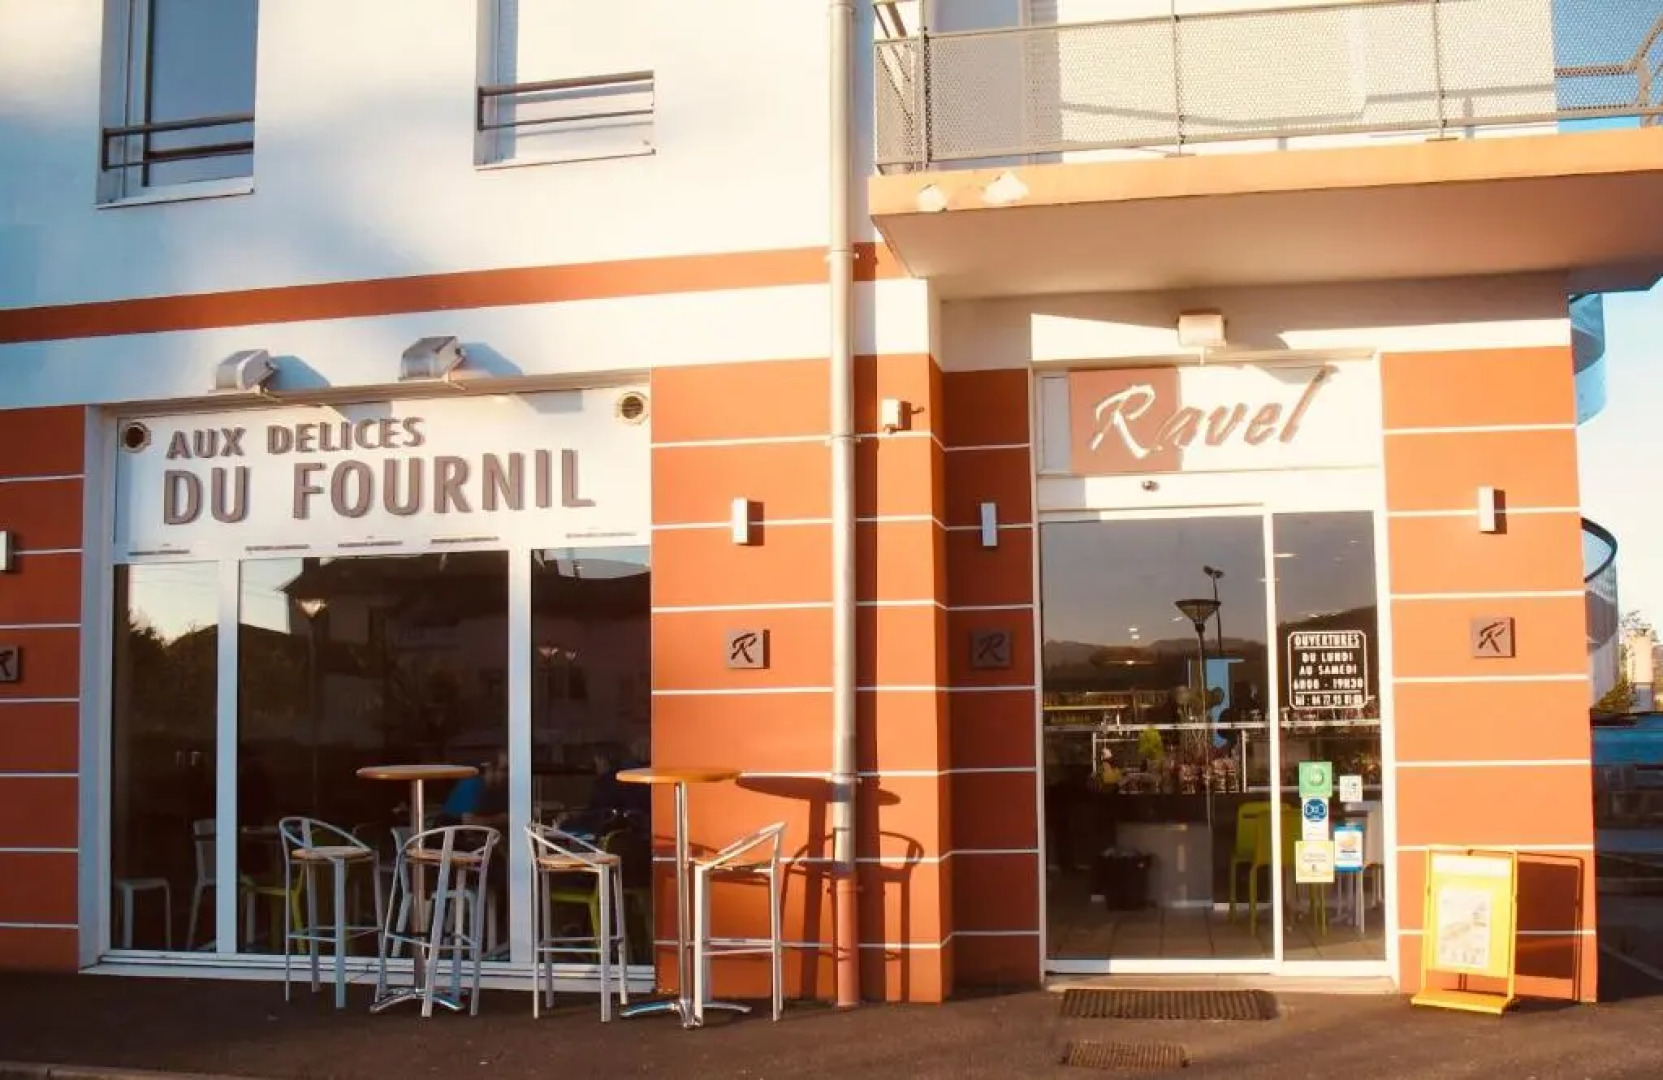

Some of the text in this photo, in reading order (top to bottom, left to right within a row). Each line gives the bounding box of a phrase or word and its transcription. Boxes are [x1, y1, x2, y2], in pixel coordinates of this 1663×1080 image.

[1092, 364, 1339, 459] Ravel
[166, 417, 425, 459] AUX DELICES
[164, 449, 597, 525] DU FOURNIL
[1294, 634, 1360, 646] OUVERTURES
[1299, 664, 1357, 675] AU SAMEDI
[1302, 652, 1353, 663] DU LUNDI
